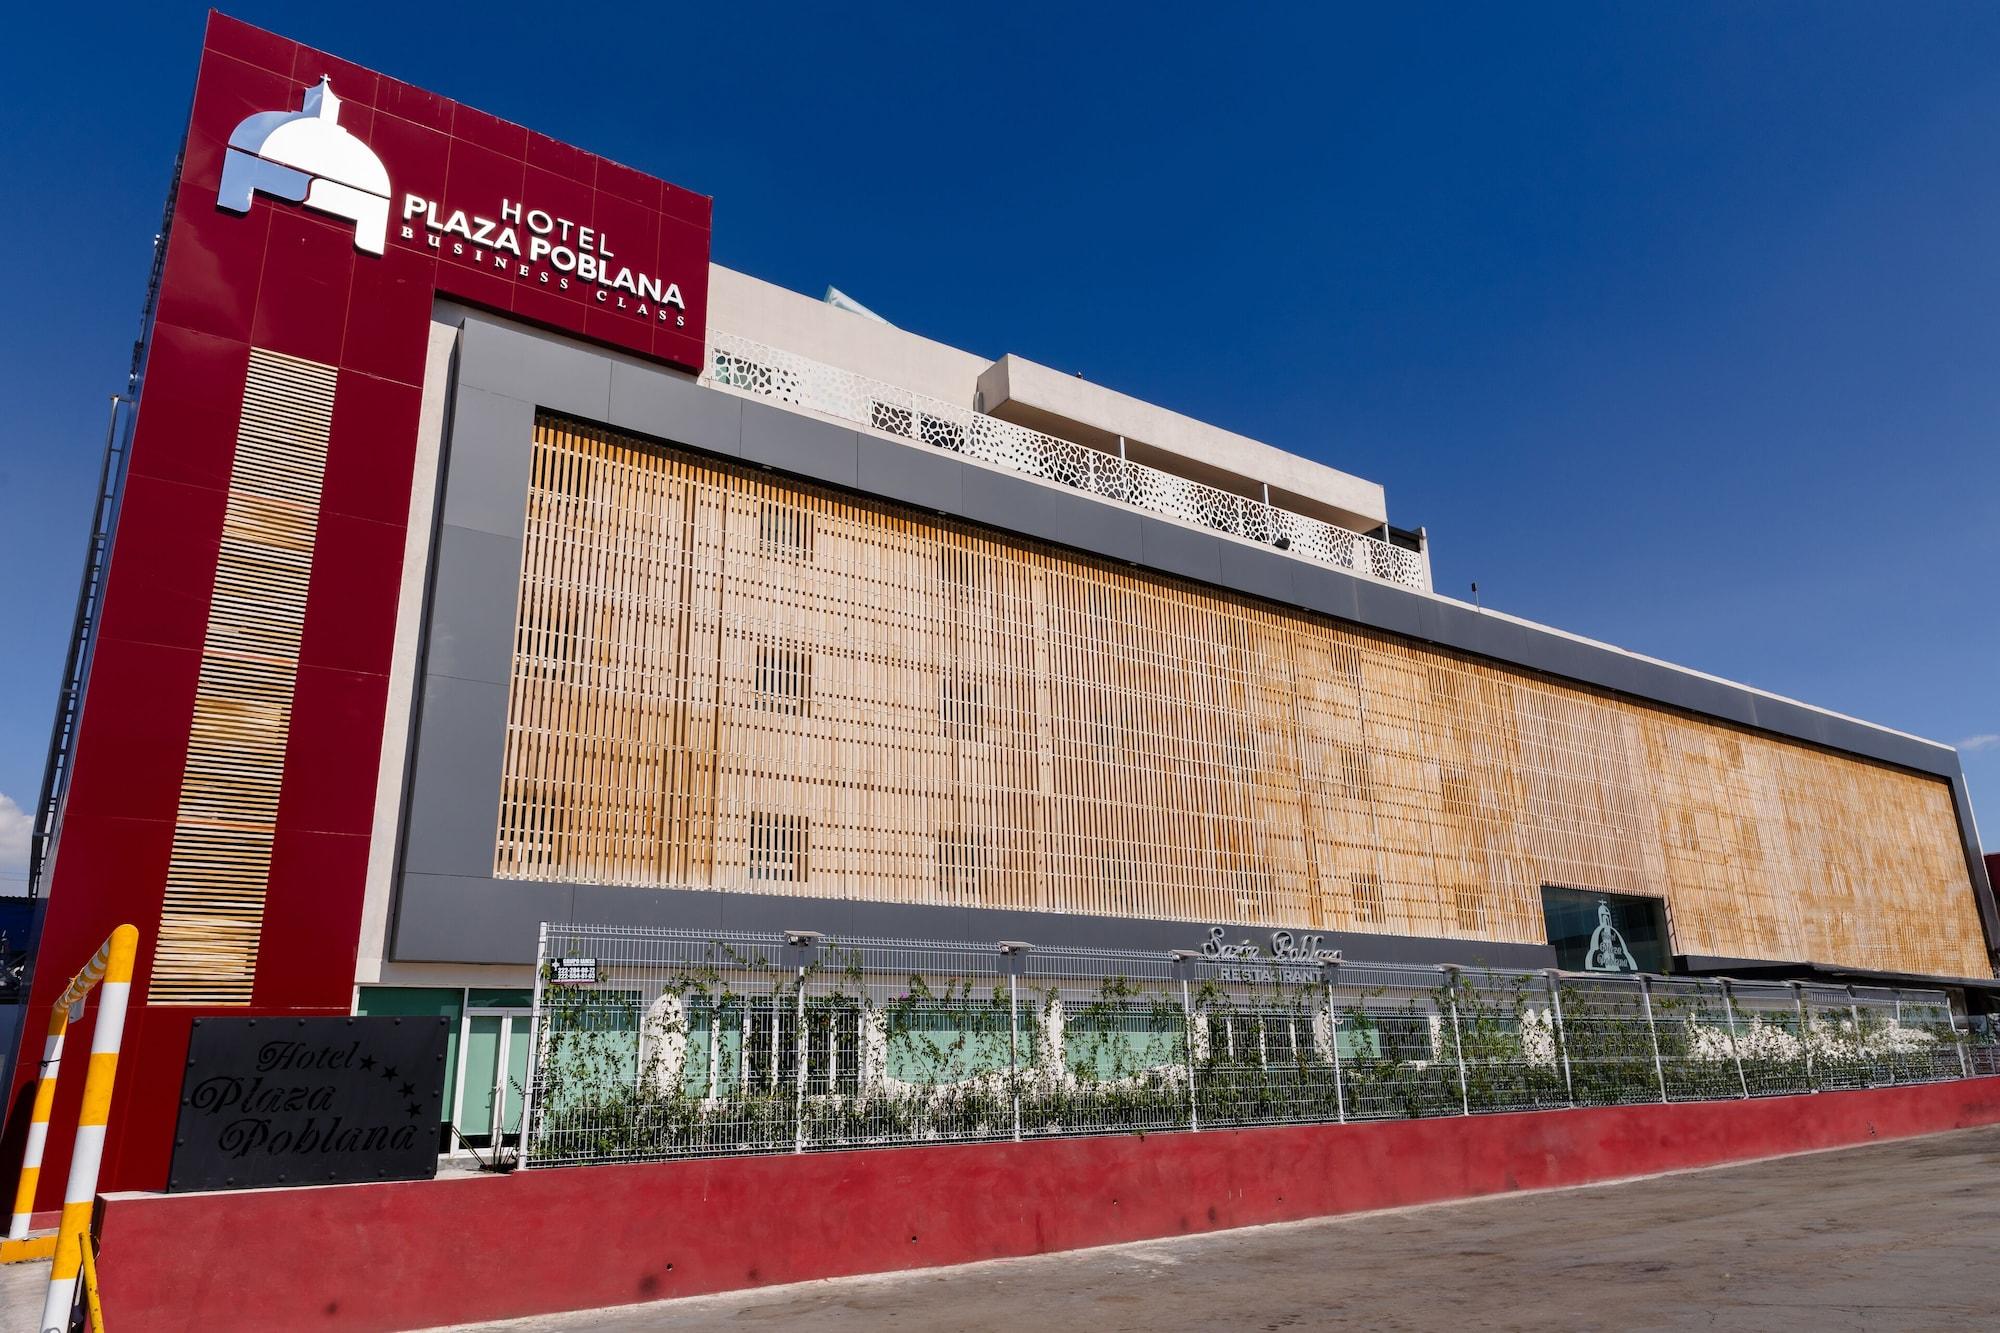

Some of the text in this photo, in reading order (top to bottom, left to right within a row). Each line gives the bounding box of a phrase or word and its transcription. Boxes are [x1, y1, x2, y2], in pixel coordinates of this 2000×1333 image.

[402, 193, 686, 310] PLAZA POBLANA
[501, 198, 614, 258] HOTEL
[400, 225, 686, 327] BUSINESS CLASS
[256, 1041, 360, 1072] Hotel
[191, 1076, 336, 1116] Plaza
[218, 1117, 418, 1160] Poblana
